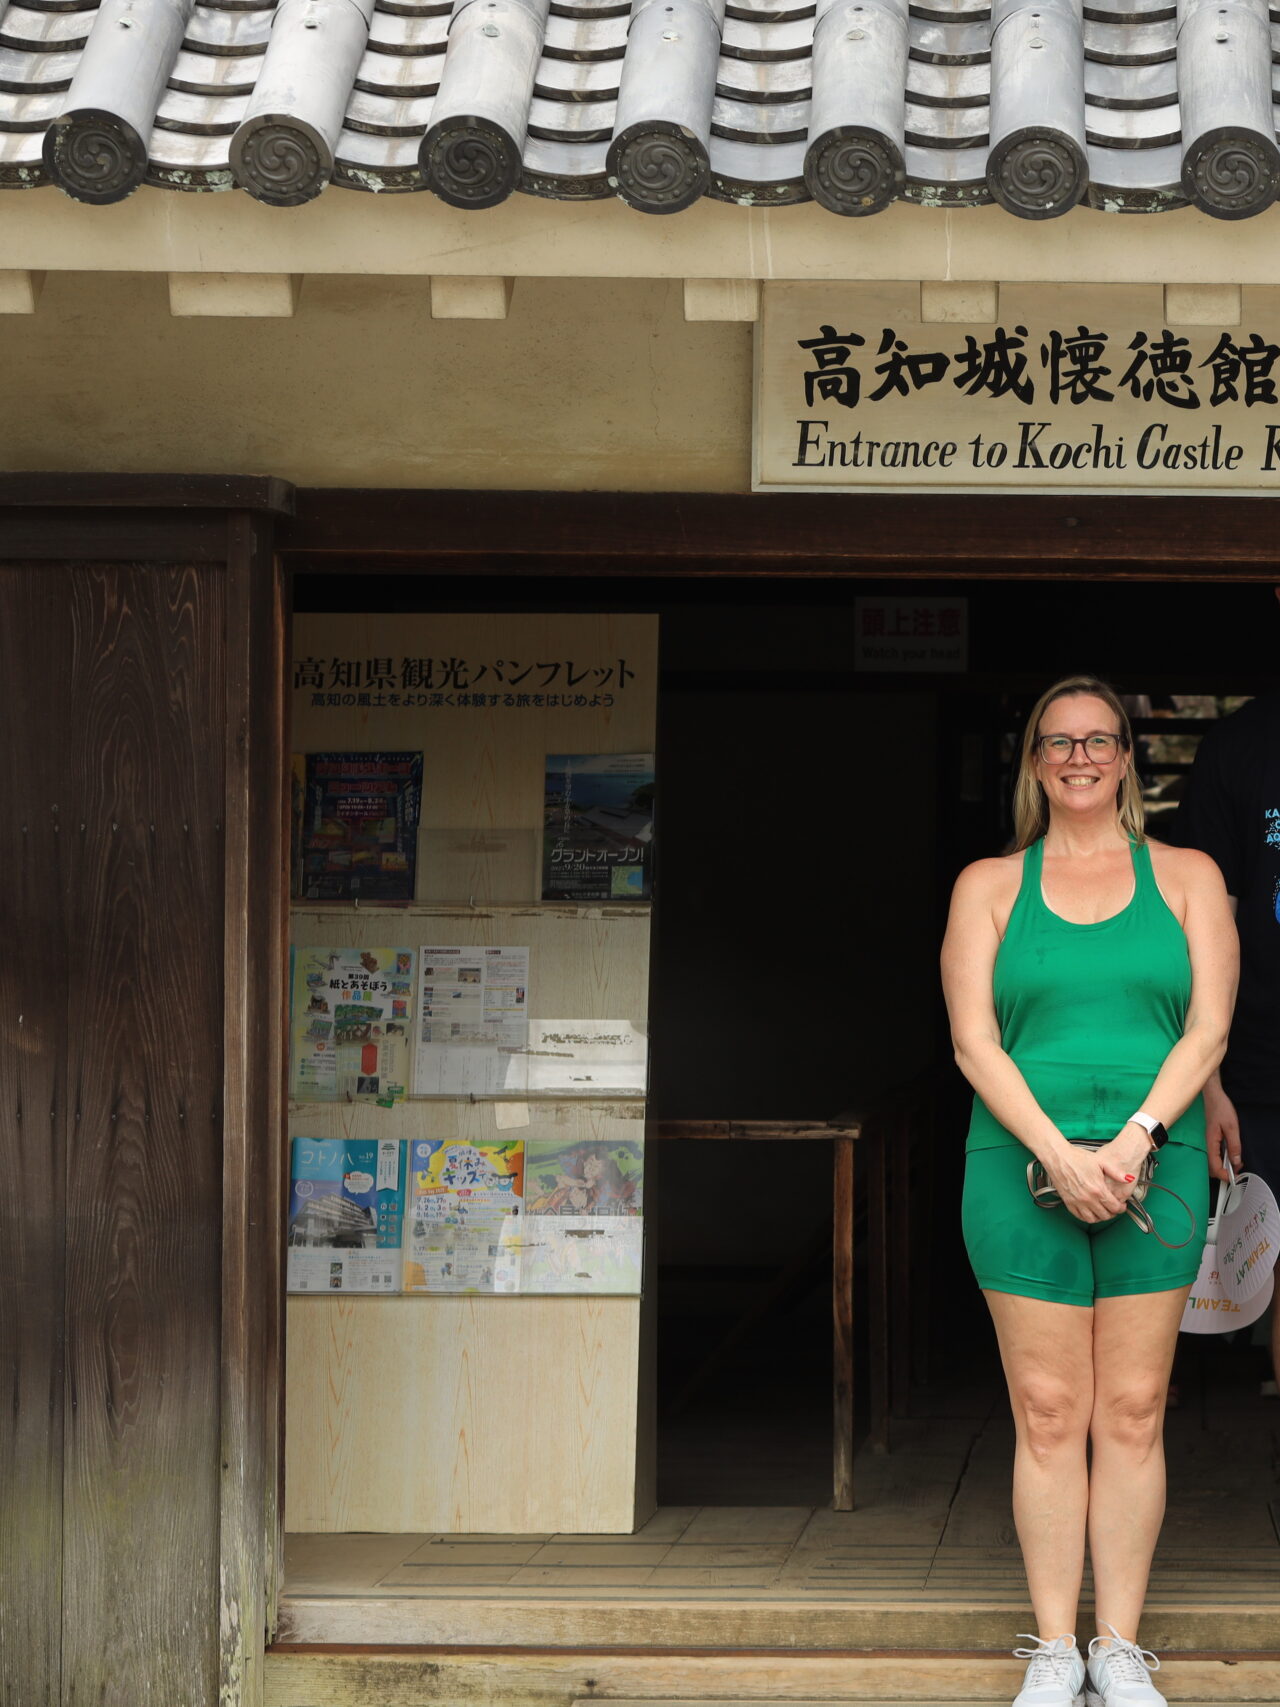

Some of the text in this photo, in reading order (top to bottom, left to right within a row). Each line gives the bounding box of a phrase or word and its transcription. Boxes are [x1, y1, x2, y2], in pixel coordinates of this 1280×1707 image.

[792, 420, 957, 468] Entrance
[968, 433, 1007, 468] to
[1013, 422, 1126, 469] Kochi
[1137, 423, 1243, 470] Castle
[293, 656, 635, 690] 高知県観光パンフレット
[310, 693, 615, 708] 高知の風土をより深く体験する旅をはじめよう
[301, 1150, 354, 1168] コトノハ
